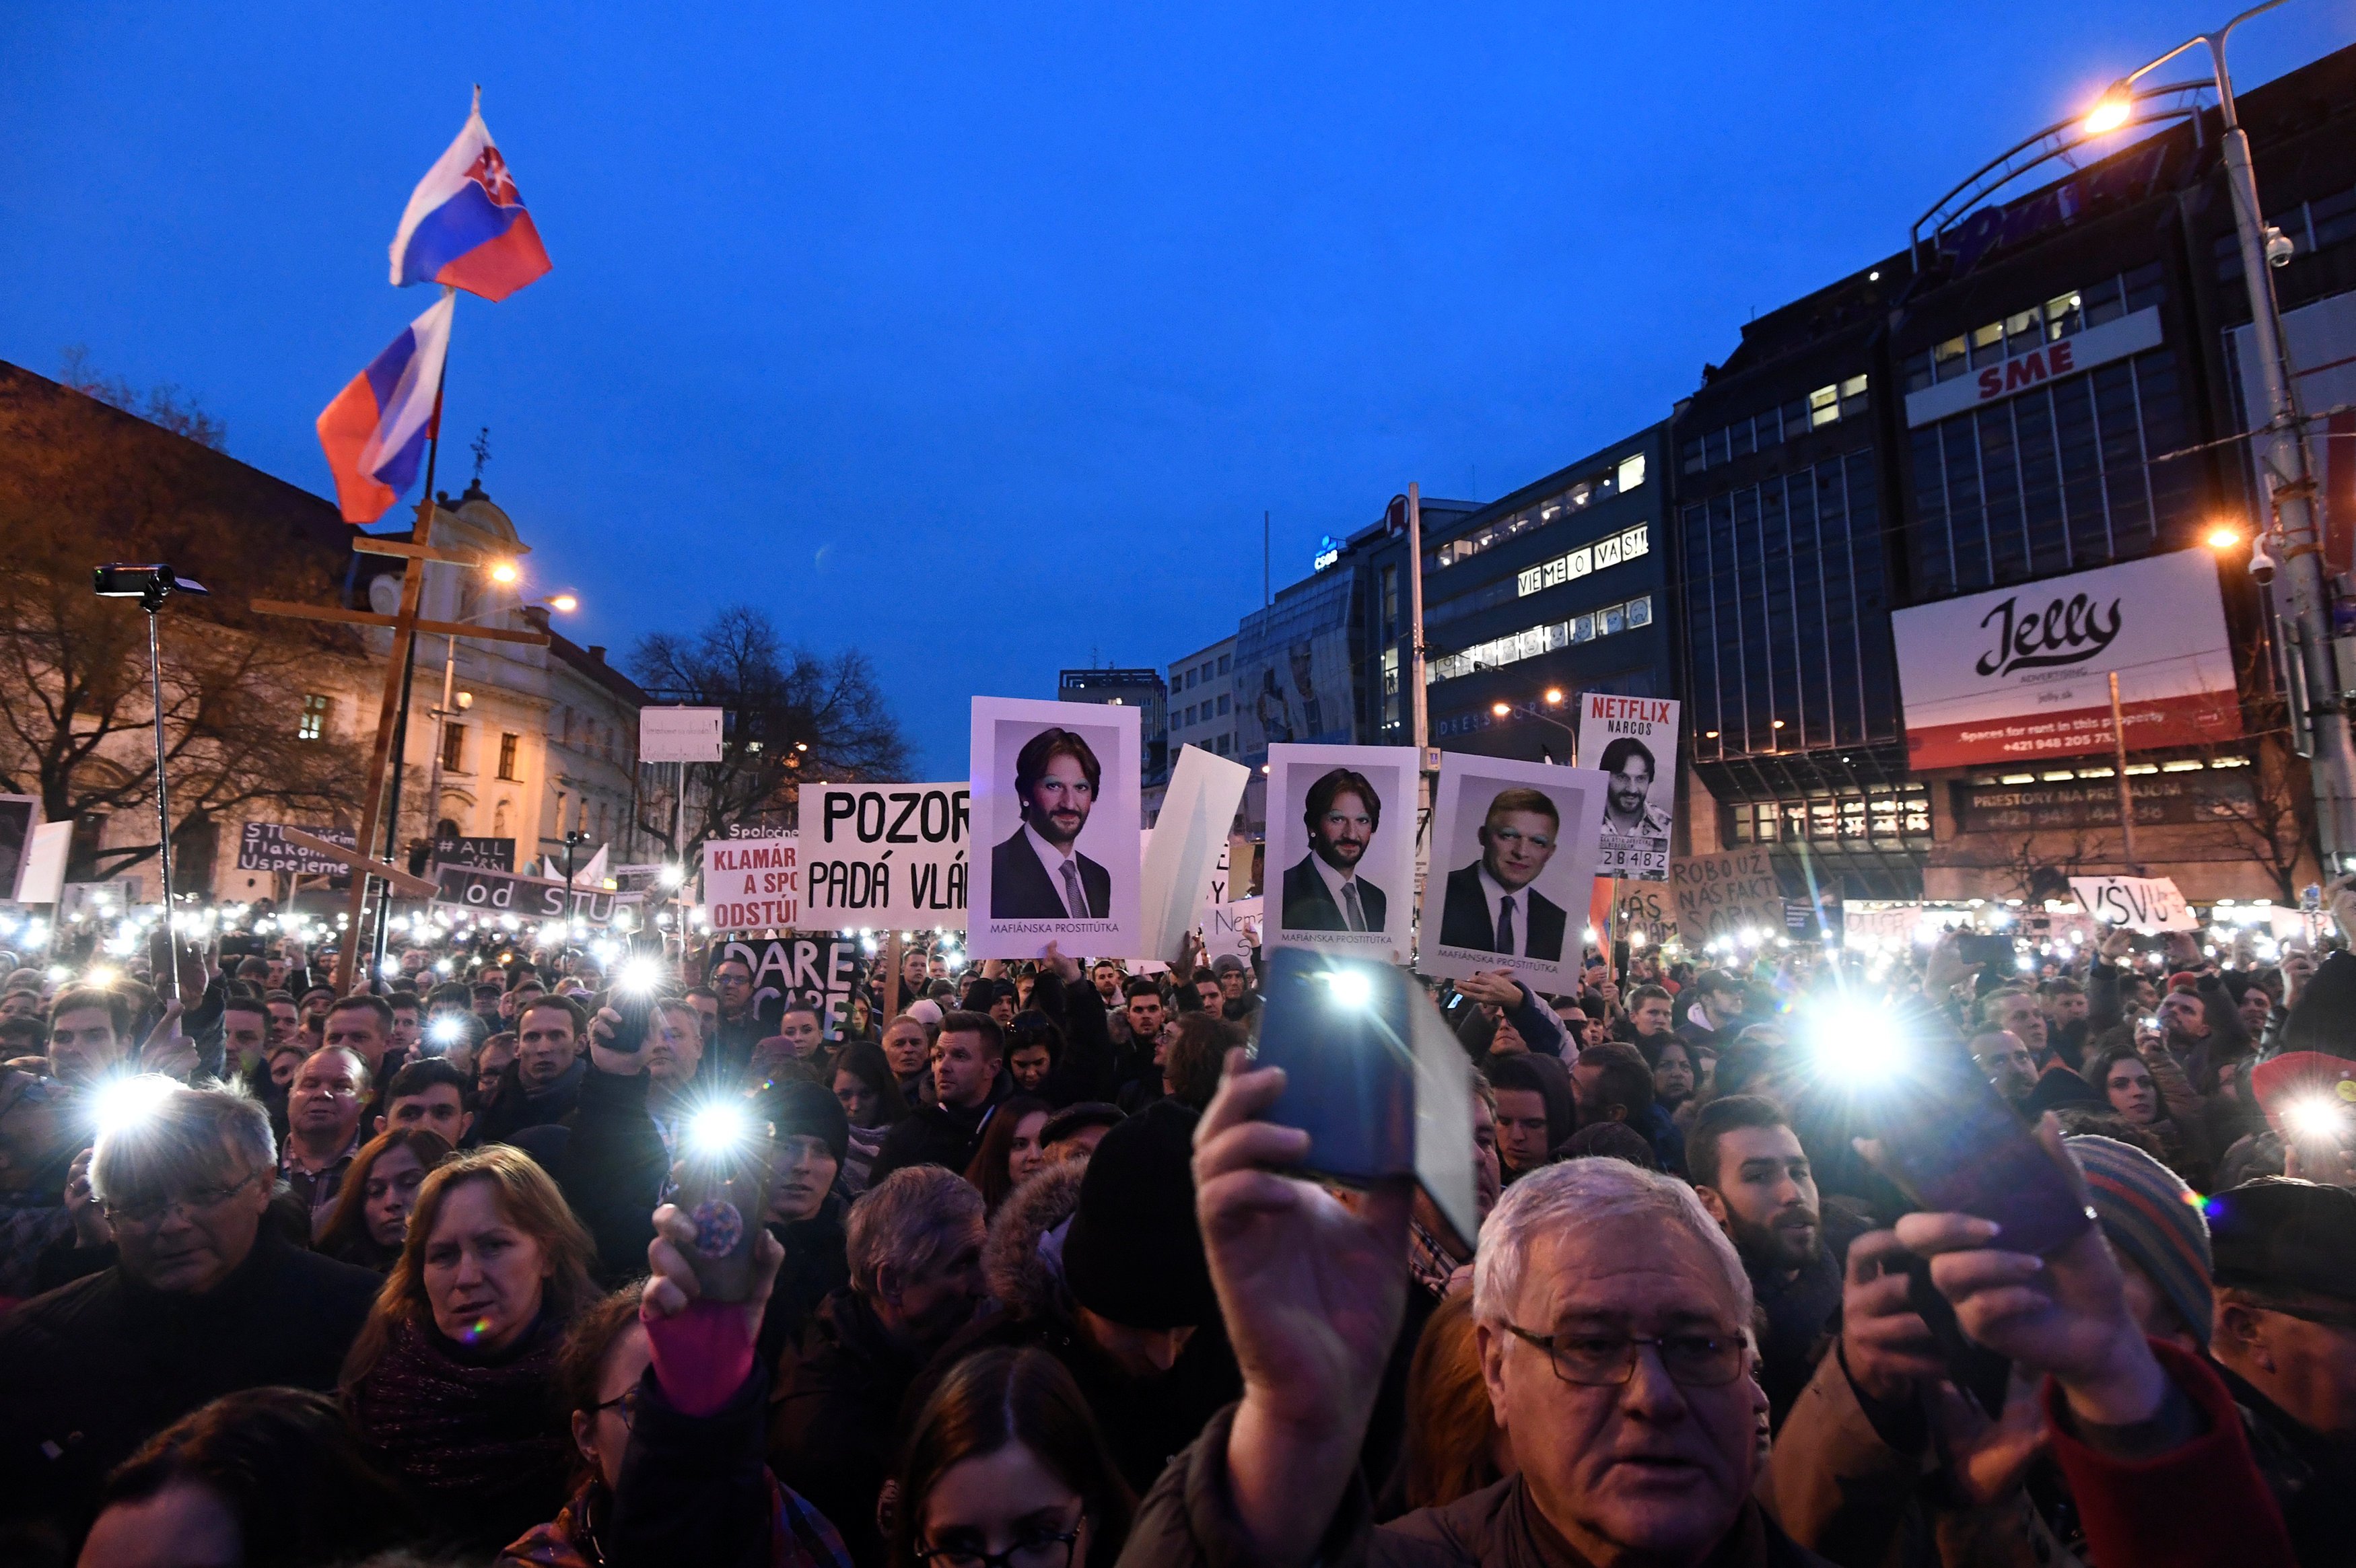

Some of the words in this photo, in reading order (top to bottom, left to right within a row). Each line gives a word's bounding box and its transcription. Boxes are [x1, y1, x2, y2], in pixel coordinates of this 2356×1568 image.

[1978, 341, 2075, 399] SME
[1575, 555, 1584, 572] O
[1976, 593, 2122, 678] Jelly
[1592, 697, 1670, 725] NETFLIX
[1608, 720, 1652, 736] NARCOS
[2005, 726, 2025, 737] for
[241, 854, 349, 874] Uspejeme
[1671, 859, 1733, 886] ROBO
[743, 874, 757, 894] A
[808, 849, 894, 909] PADÁ
[911, 850, 968, 909] VLÁ
[466, 881, 514, 908] od
[714, 894, 797, 928] ODSTÚ
[990, 921, 1052, 933] MAFIÁNSKA
[1055, 921, 1119, 933] PROSTITÚTKA
[1281, 931, 1334, 943] MAFIÁNSKA
[1336, 933, 1392, 943] PROSTITÚTKA
[1437, 949, 1494, 964] MAFIÁNSKA
[1496, 957, 1558, 974] PROSTITÚTKA
